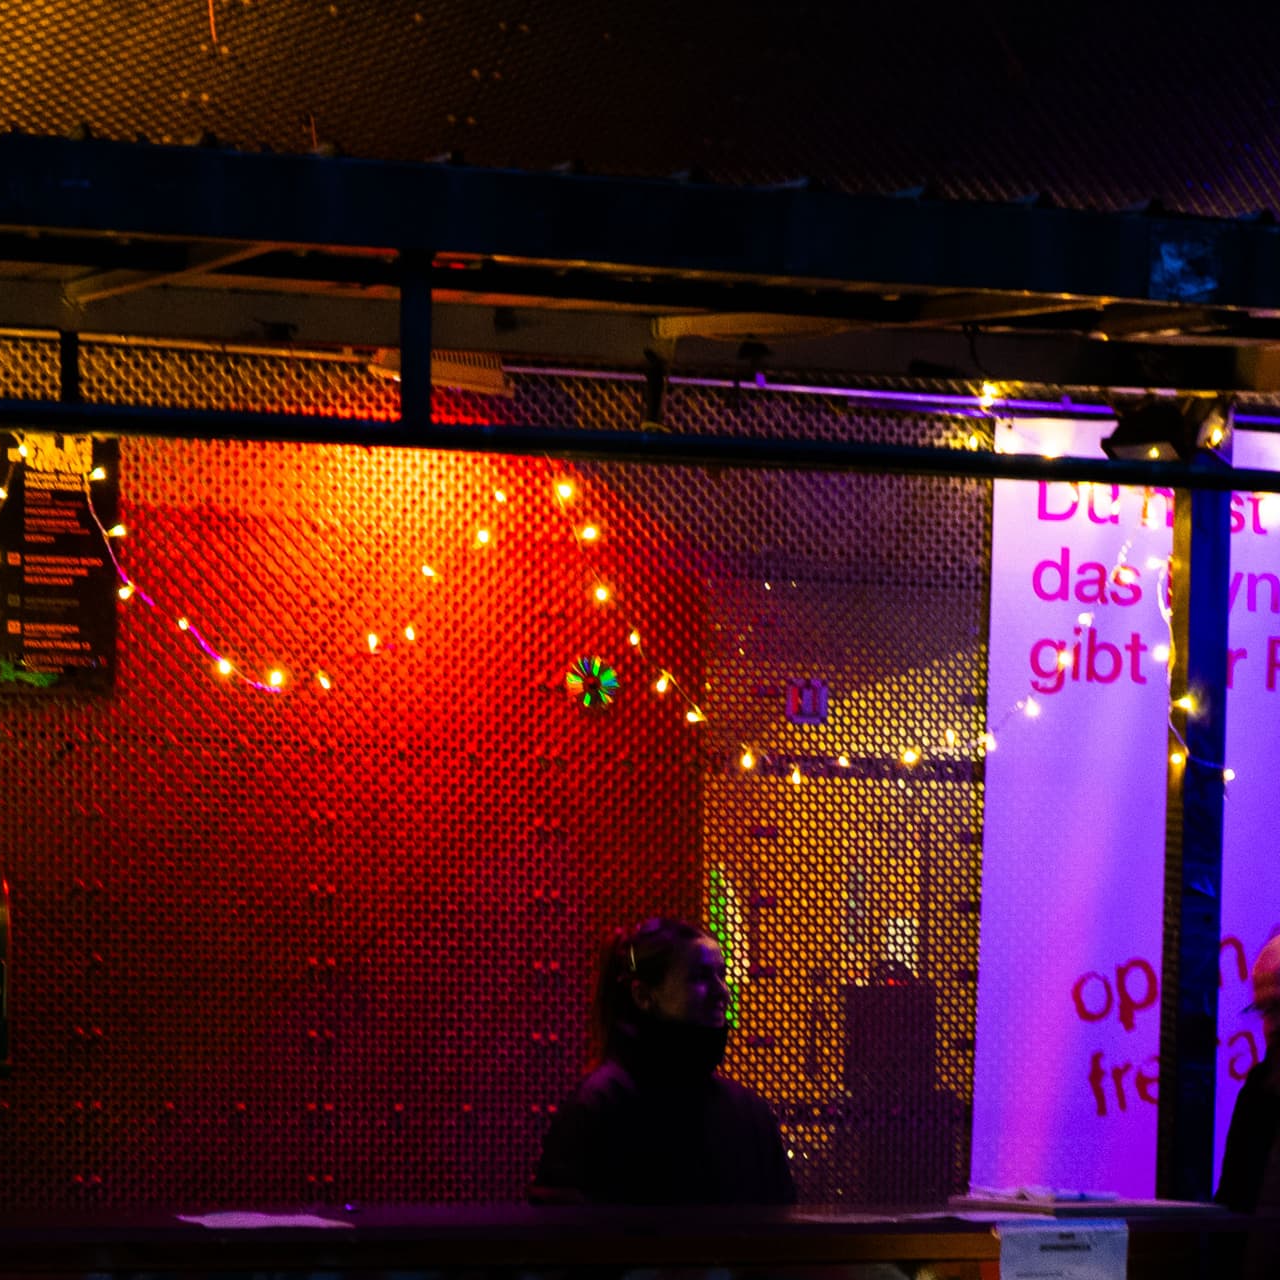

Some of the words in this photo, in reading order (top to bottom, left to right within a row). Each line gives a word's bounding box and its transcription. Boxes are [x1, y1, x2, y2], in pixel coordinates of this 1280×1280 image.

[1032, 547, 1142, 607] das
[1029, 627, 1148, 695] gibt
[1072, 934, 1249, 1033] opn
